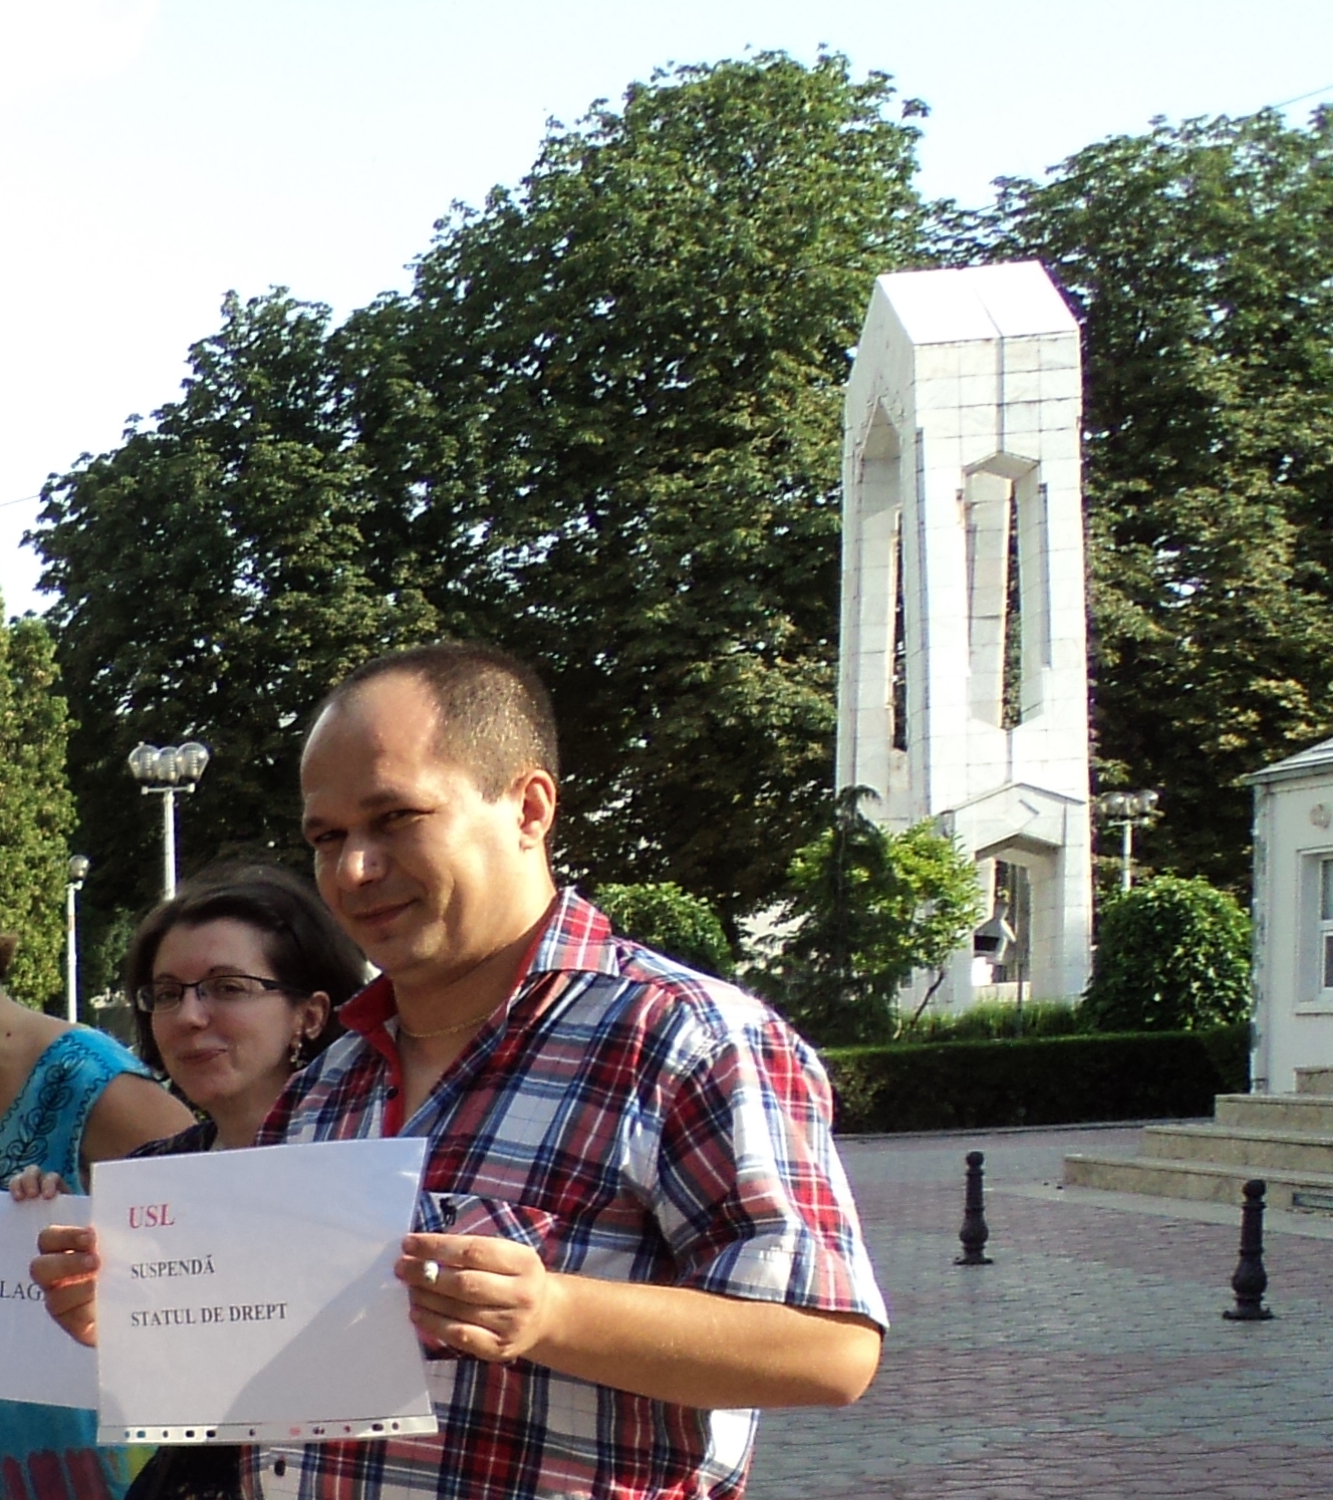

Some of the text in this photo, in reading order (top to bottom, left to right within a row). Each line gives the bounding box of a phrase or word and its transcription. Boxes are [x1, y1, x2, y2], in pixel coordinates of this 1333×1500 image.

[129, 1204, 175, 1230] USL
[130, 1254, 215, 1279] SUSPENDĂ
[130, 1303, 288, 1327] STATUL DE DREPT
